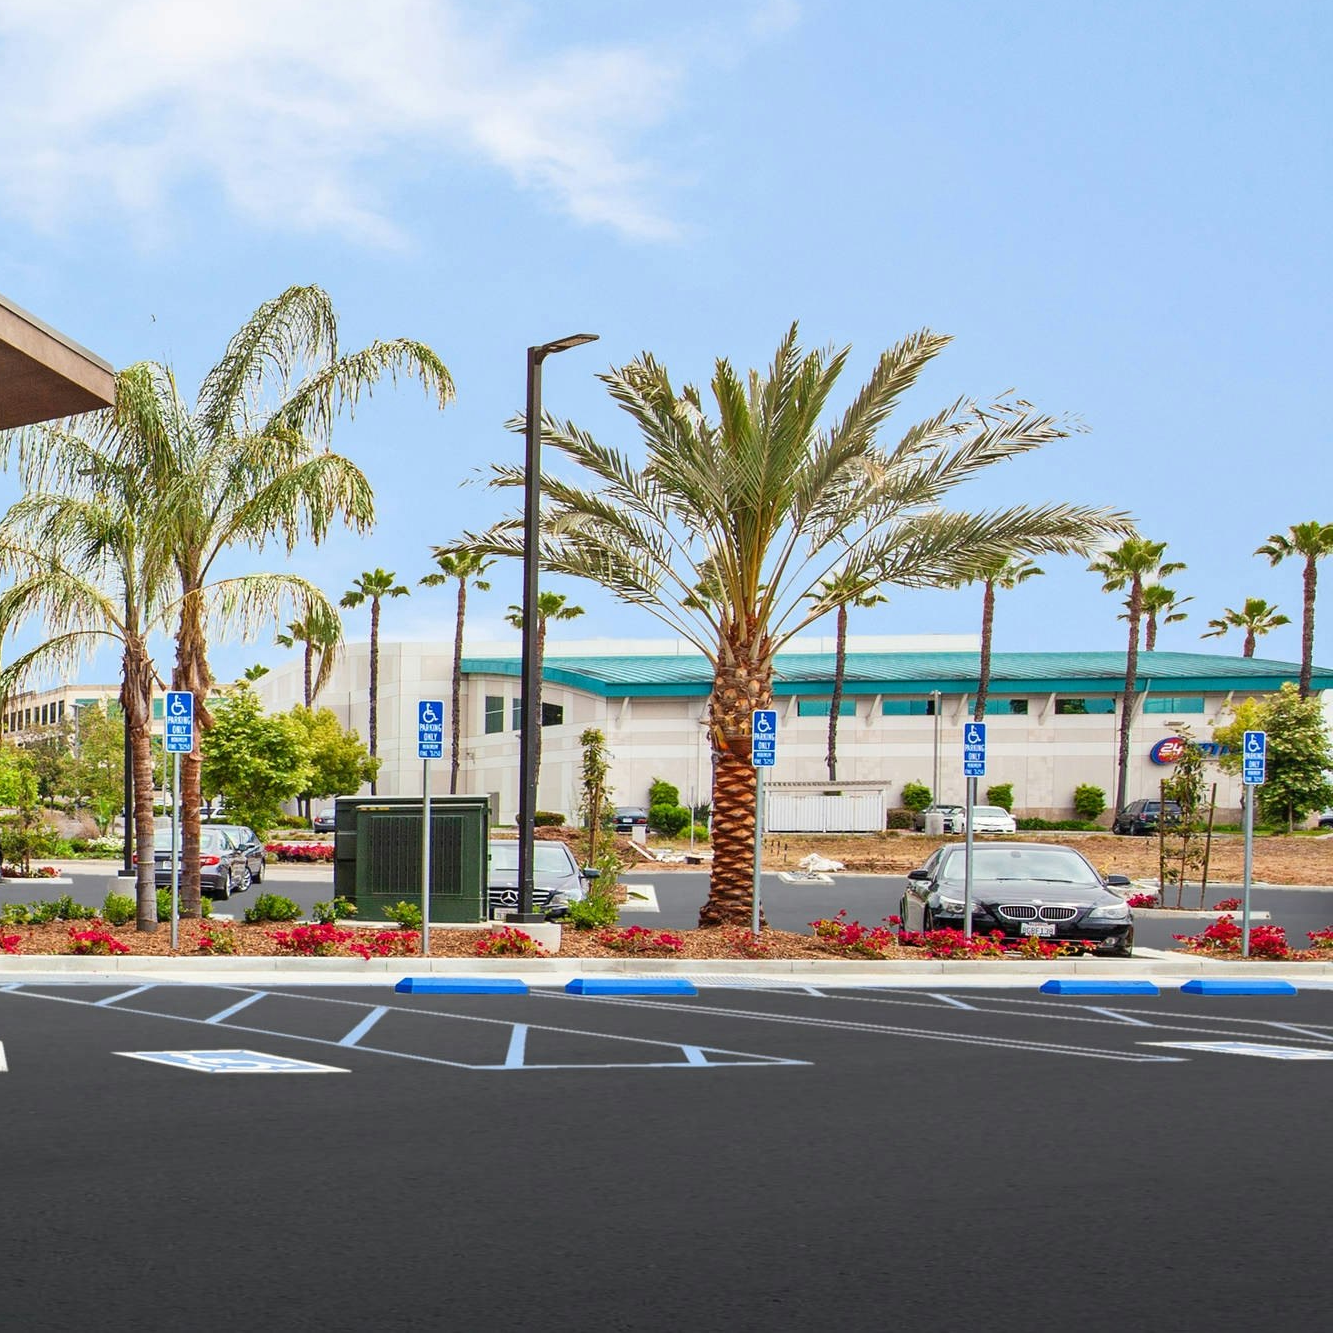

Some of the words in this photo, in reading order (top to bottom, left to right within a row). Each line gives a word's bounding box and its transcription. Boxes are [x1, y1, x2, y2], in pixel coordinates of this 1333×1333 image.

[168, 716, 191, 725] PARKING
[172, 725, 186, 734] ONLY
[420, 723, 442, 732] PARKING
[424, 733, 437, 741] ONLY
[754, 732, 775, 741] PARKING
[758, 741, 771, 750] ONLY
[965, 744, 984, 752] PARKING
[1160, 743, 1183, 755] 24
